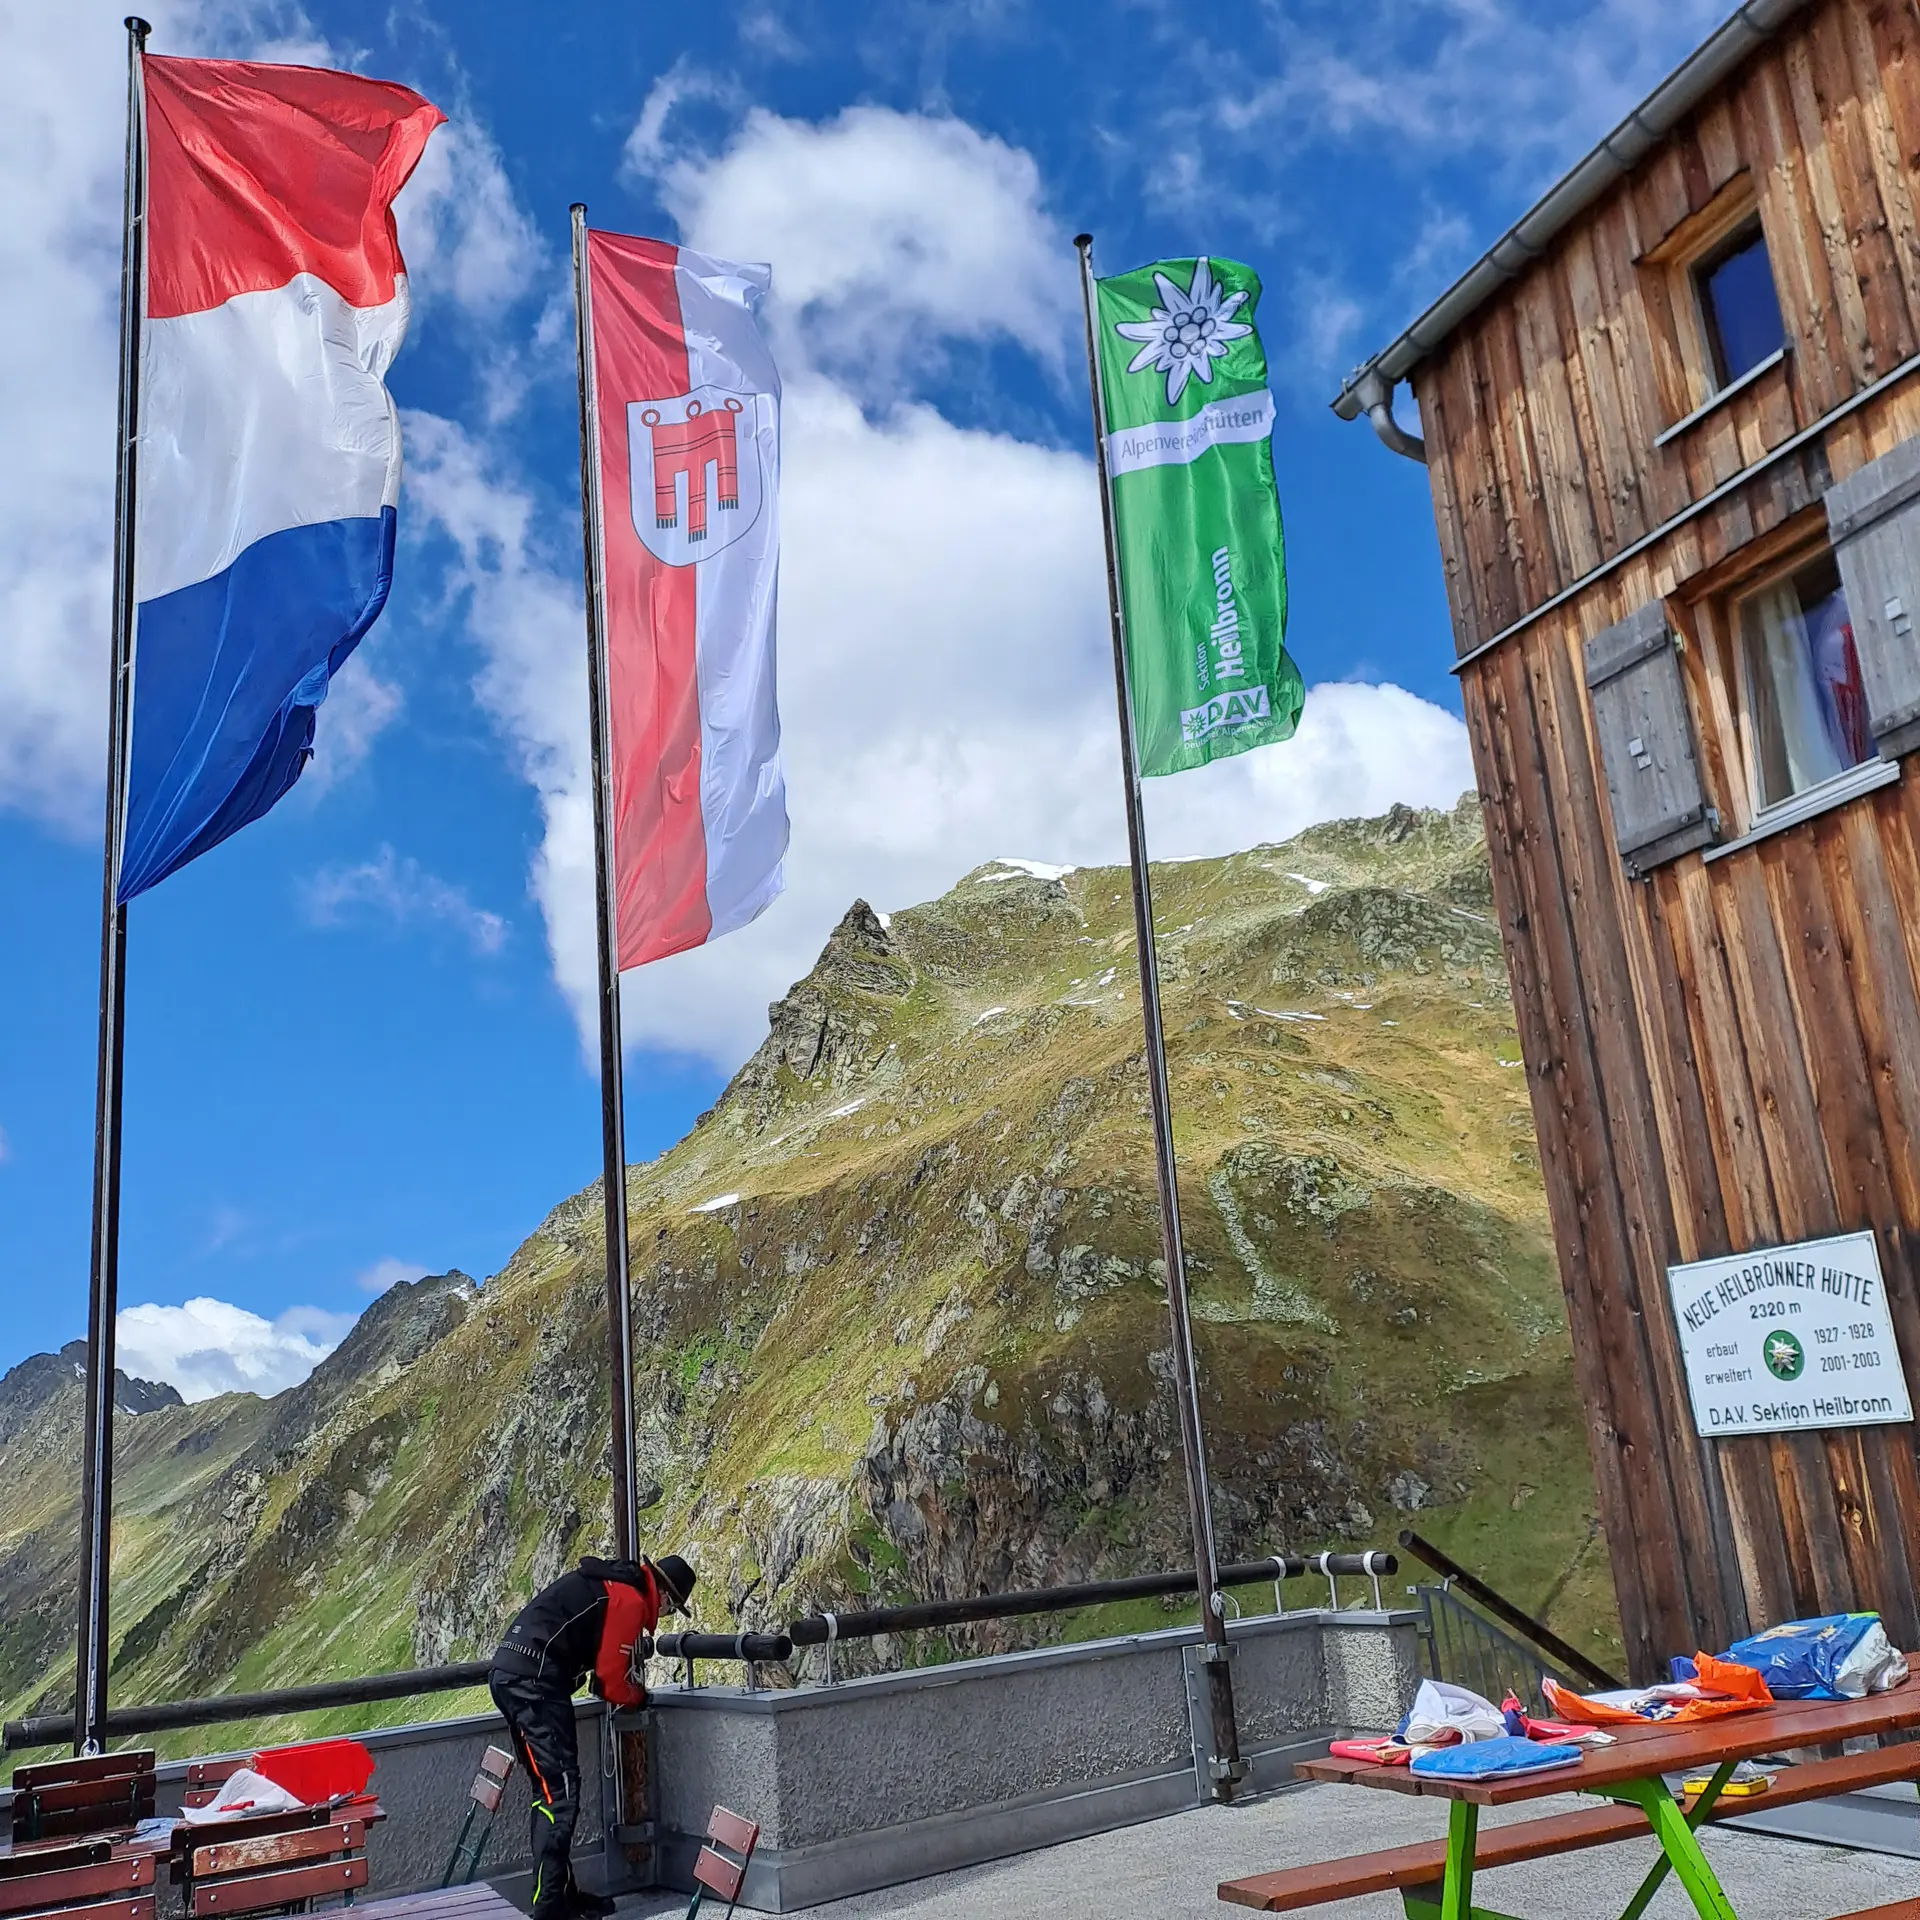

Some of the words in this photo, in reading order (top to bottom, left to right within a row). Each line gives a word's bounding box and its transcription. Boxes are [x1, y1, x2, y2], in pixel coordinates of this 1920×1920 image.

[1210, 546, 1245, 681] Heilbronn
[1196, 641, 1211, 692] Sektion
[1207, 690, 1264, 727] DAV
[1683, 1290, 1720, 1333] NEUE
[1715, 1260, 1816, 1308] HEILBRONNER
[1821, 1266, 1875, 1307] HÜTTE
[1750, 1301, 1786, 1320] 2320
[1790, 1303, 1802, 1314] m
[1814, 1327, 1839, 1345] 1927
[1848, 1322, 1875, 1341] 1928
[1706, 1341, 1739, 1358] erbaut
[1705, 1367, 1753, 1385] erweitert
[1709, 1405, 1749, 1426] D.A.V.
[1752, 1400, 1810, 1422] Sektion
[1813, 1397, 1893, 1418] Heilbronn
